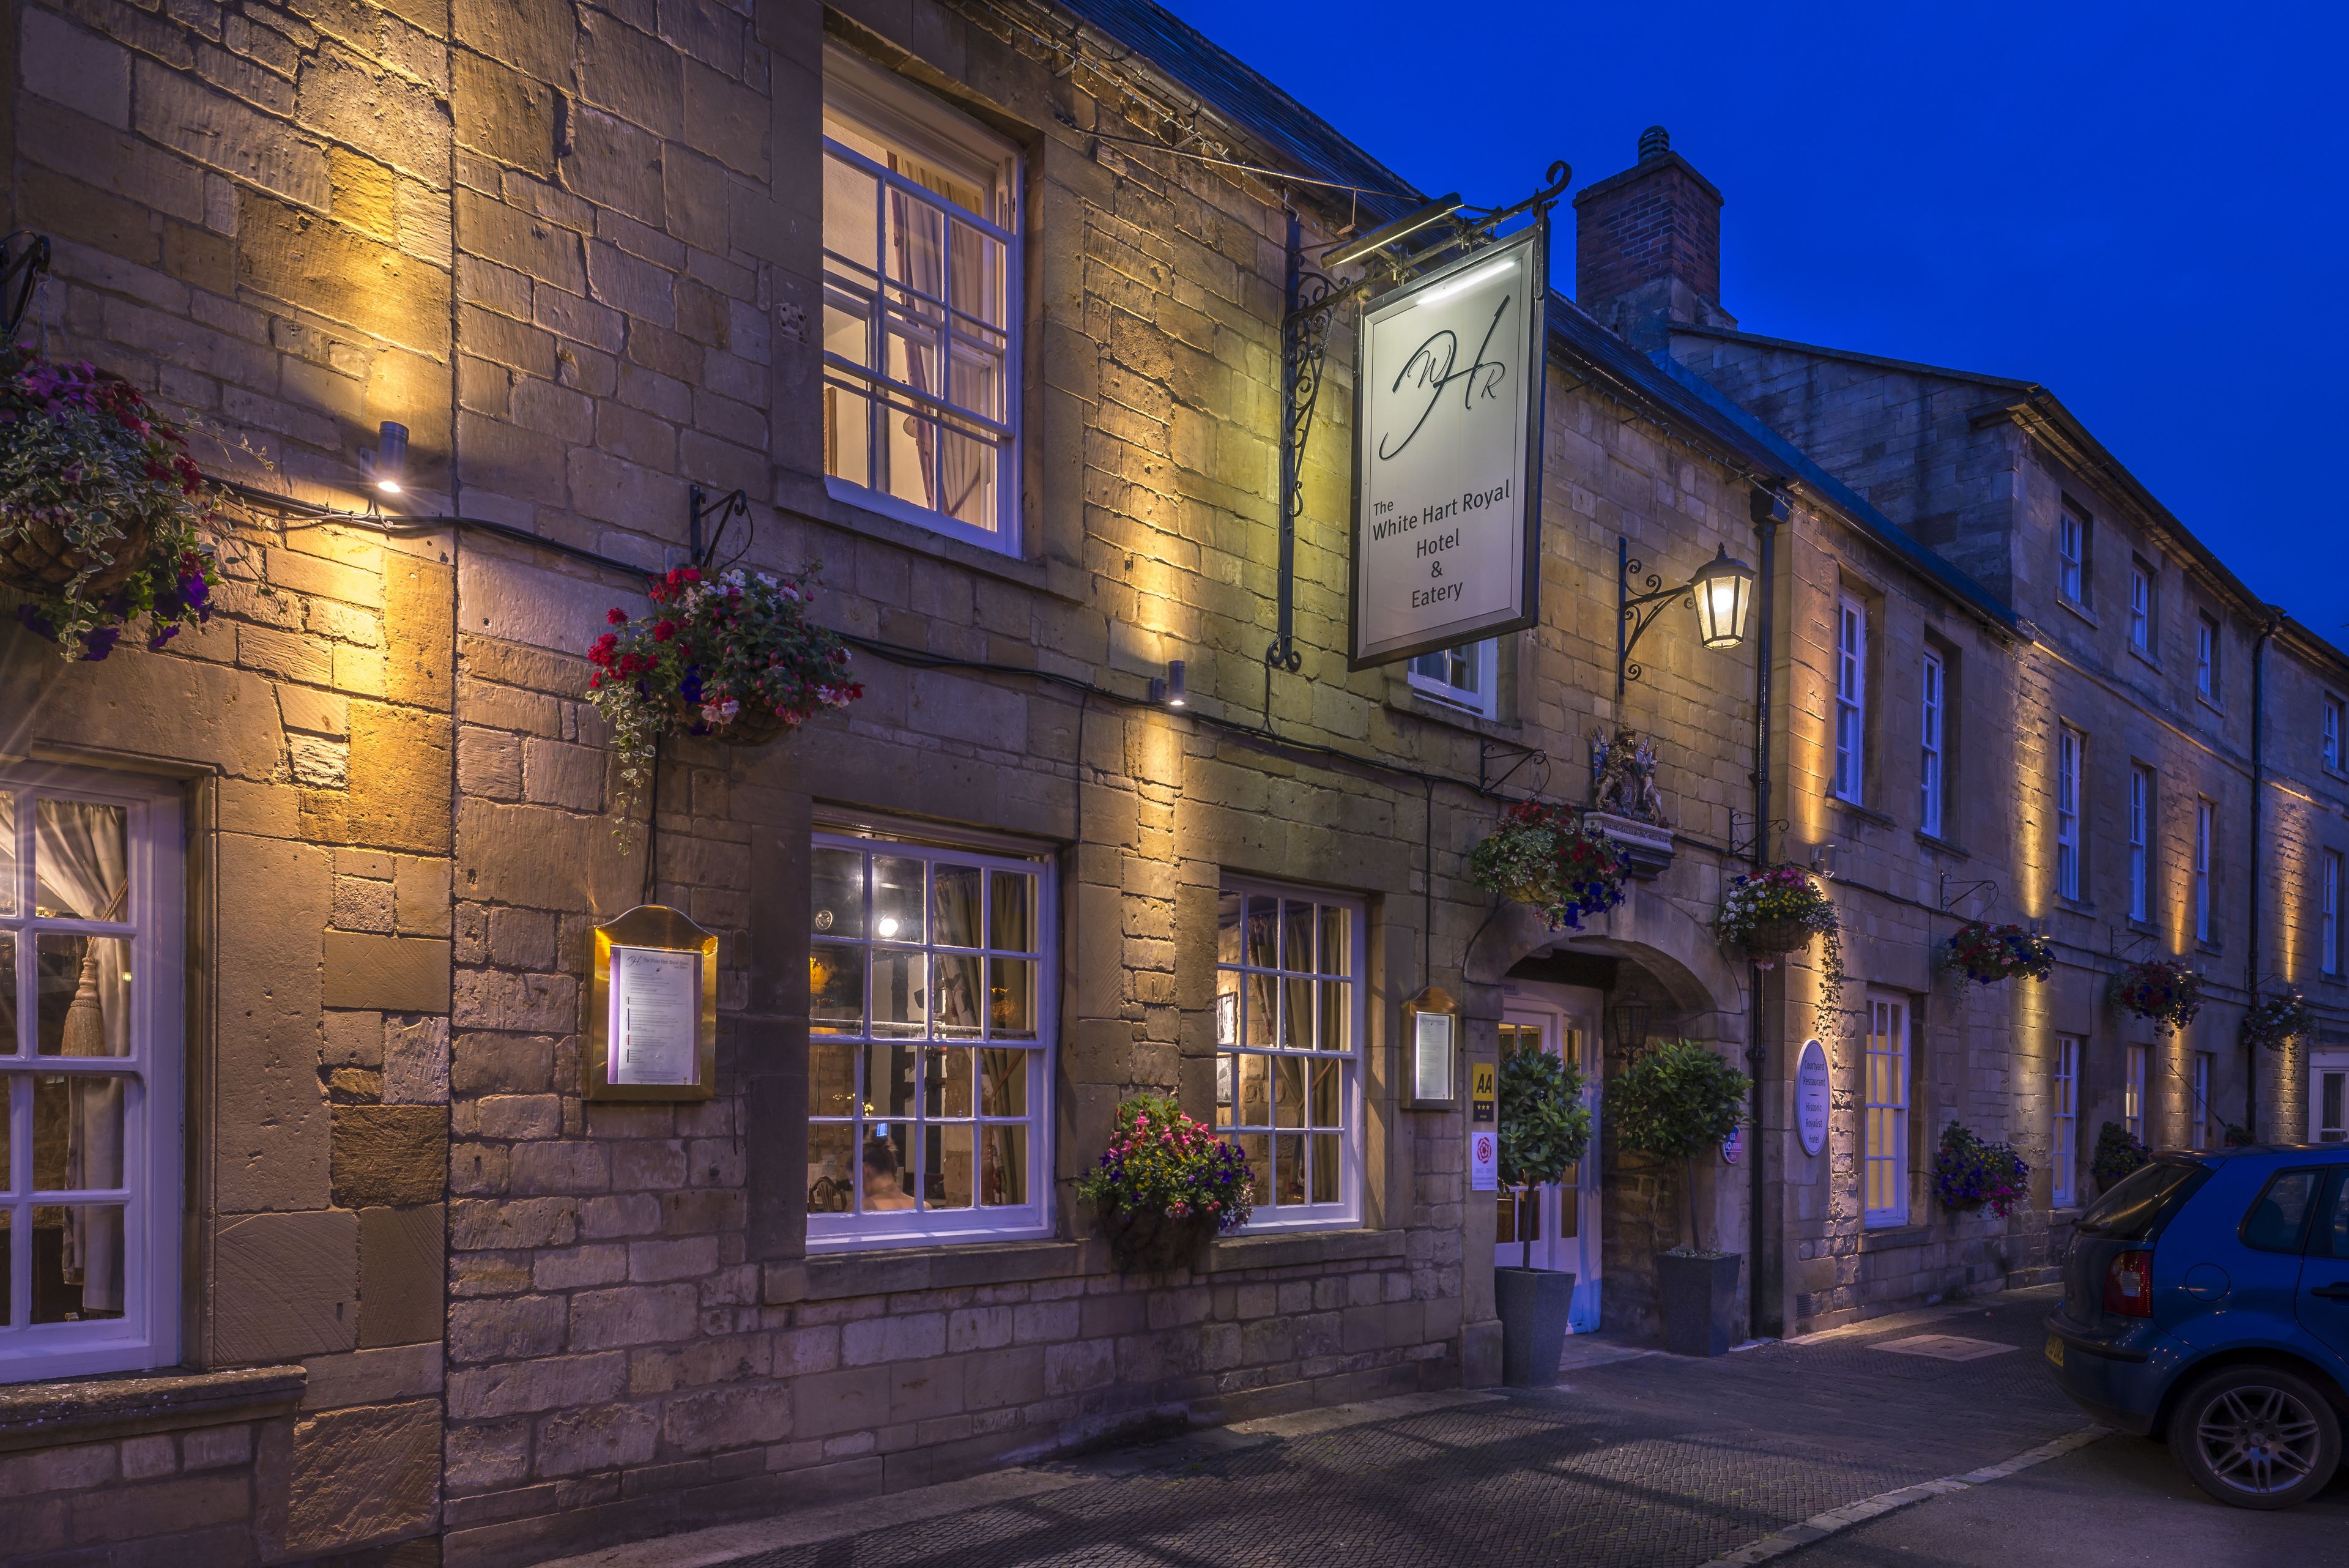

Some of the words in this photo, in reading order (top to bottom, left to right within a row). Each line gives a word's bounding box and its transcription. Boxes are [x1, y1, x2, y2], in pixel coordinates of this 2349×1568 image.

[1373, 500, 1393, 516] The
[1373, 514, 1417, 541] White
[1423, 499, 1458, 525] Hart
[1463, 478, 1510, 512] Royal
[1417, 527, 1460, 559] Hotel
[1431, 560, 1444, 578] &
[1412, 582, 1463, 609] Eatery
[1804, 1060, 1825, 1072] Courtyard
[1476, 1073, 1492, 1094] AA
[1803, 1076, 1825, 1087] Restaurant
[1806, 1102, 1822, 1112] Historic
[1805, 1118, 1822, 1129] Royalist
[1808, 1134, 1820, 1143] Hotel
